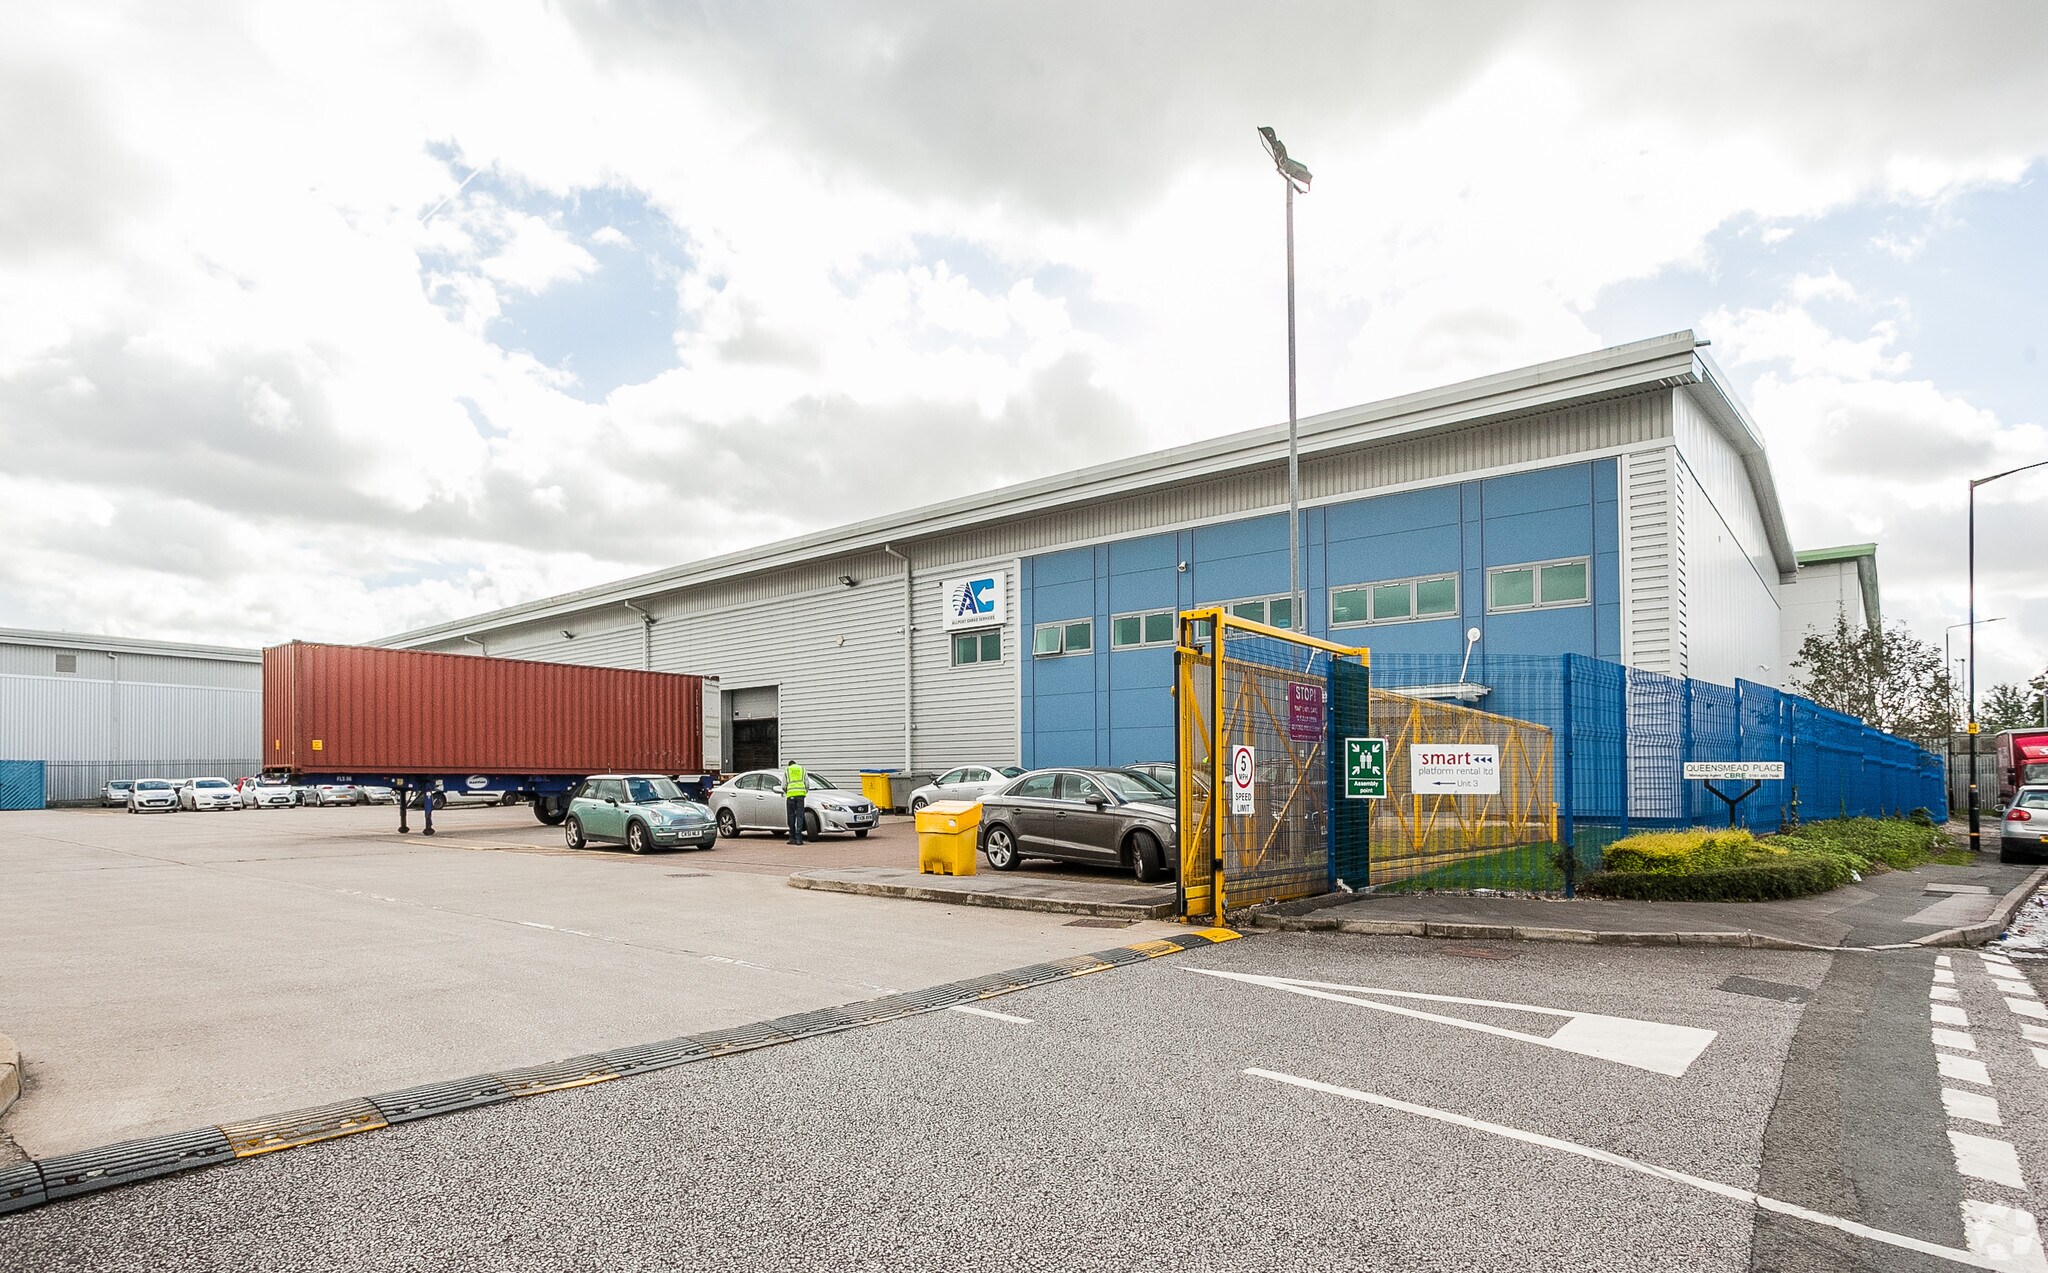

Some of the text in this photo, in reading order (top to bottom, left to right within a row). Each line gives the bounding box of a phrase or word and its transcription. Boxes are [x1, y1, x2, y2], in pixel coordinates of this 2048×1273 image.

[1295, 686, 1317, 702] STOP!
[1240, 755, 1247, 771] 5
[1422, 752, 1471, 765] smart
[1418, 767, 1494, 776] platform rental ltd
[1686, 764, 1782, 772] QUEENSMEAD PLACE
[1235, 792, 1252, 801] SPEED
[1236, 804, 1250, 812] LIMIT
